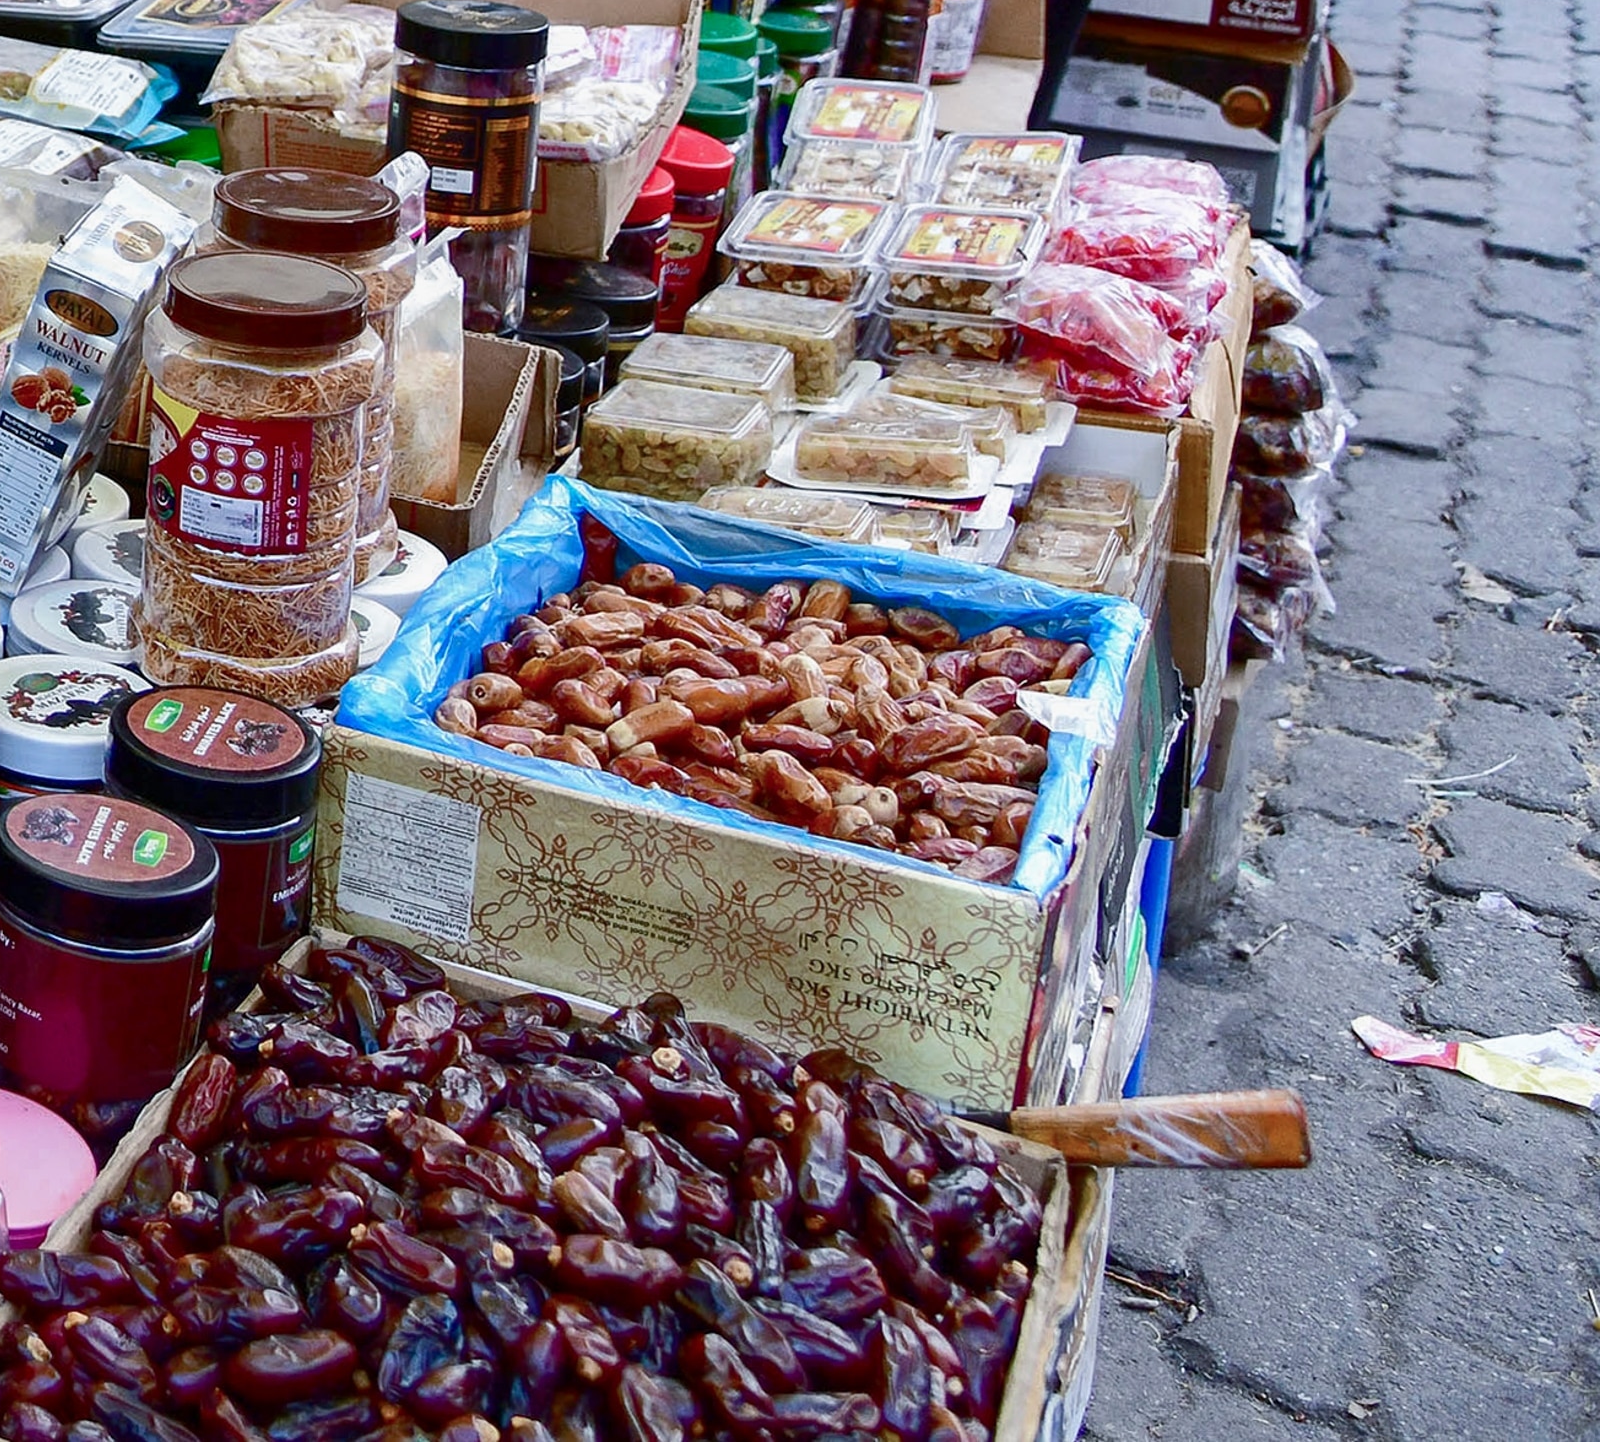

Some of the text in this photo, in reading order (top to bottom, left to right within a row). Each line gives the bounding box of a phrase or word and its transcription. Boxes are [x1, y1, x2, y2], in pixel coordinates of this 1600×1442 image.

[54, 295, 95, 325] PAYA
[36, 319, 107, 364] WALNUT
[36, 342, 92, 375] KERNELS
[36, 430, 55, 446] Facts
[194, 701, 237, 756] EMIRATES BLACK
[77, 807, 111, 865] EMIRATES BLACK
[390, 915, 432, 934] nutritive
[393, 907, 465, 932] Nutrition Facts
[0, 934, 10, 946] by
[809, 959, 852, 982] 5KG
[17, 1001, 43, 1021] Bazar,
[788, 976, 990, 1042] NET WEIGHT 5KG
